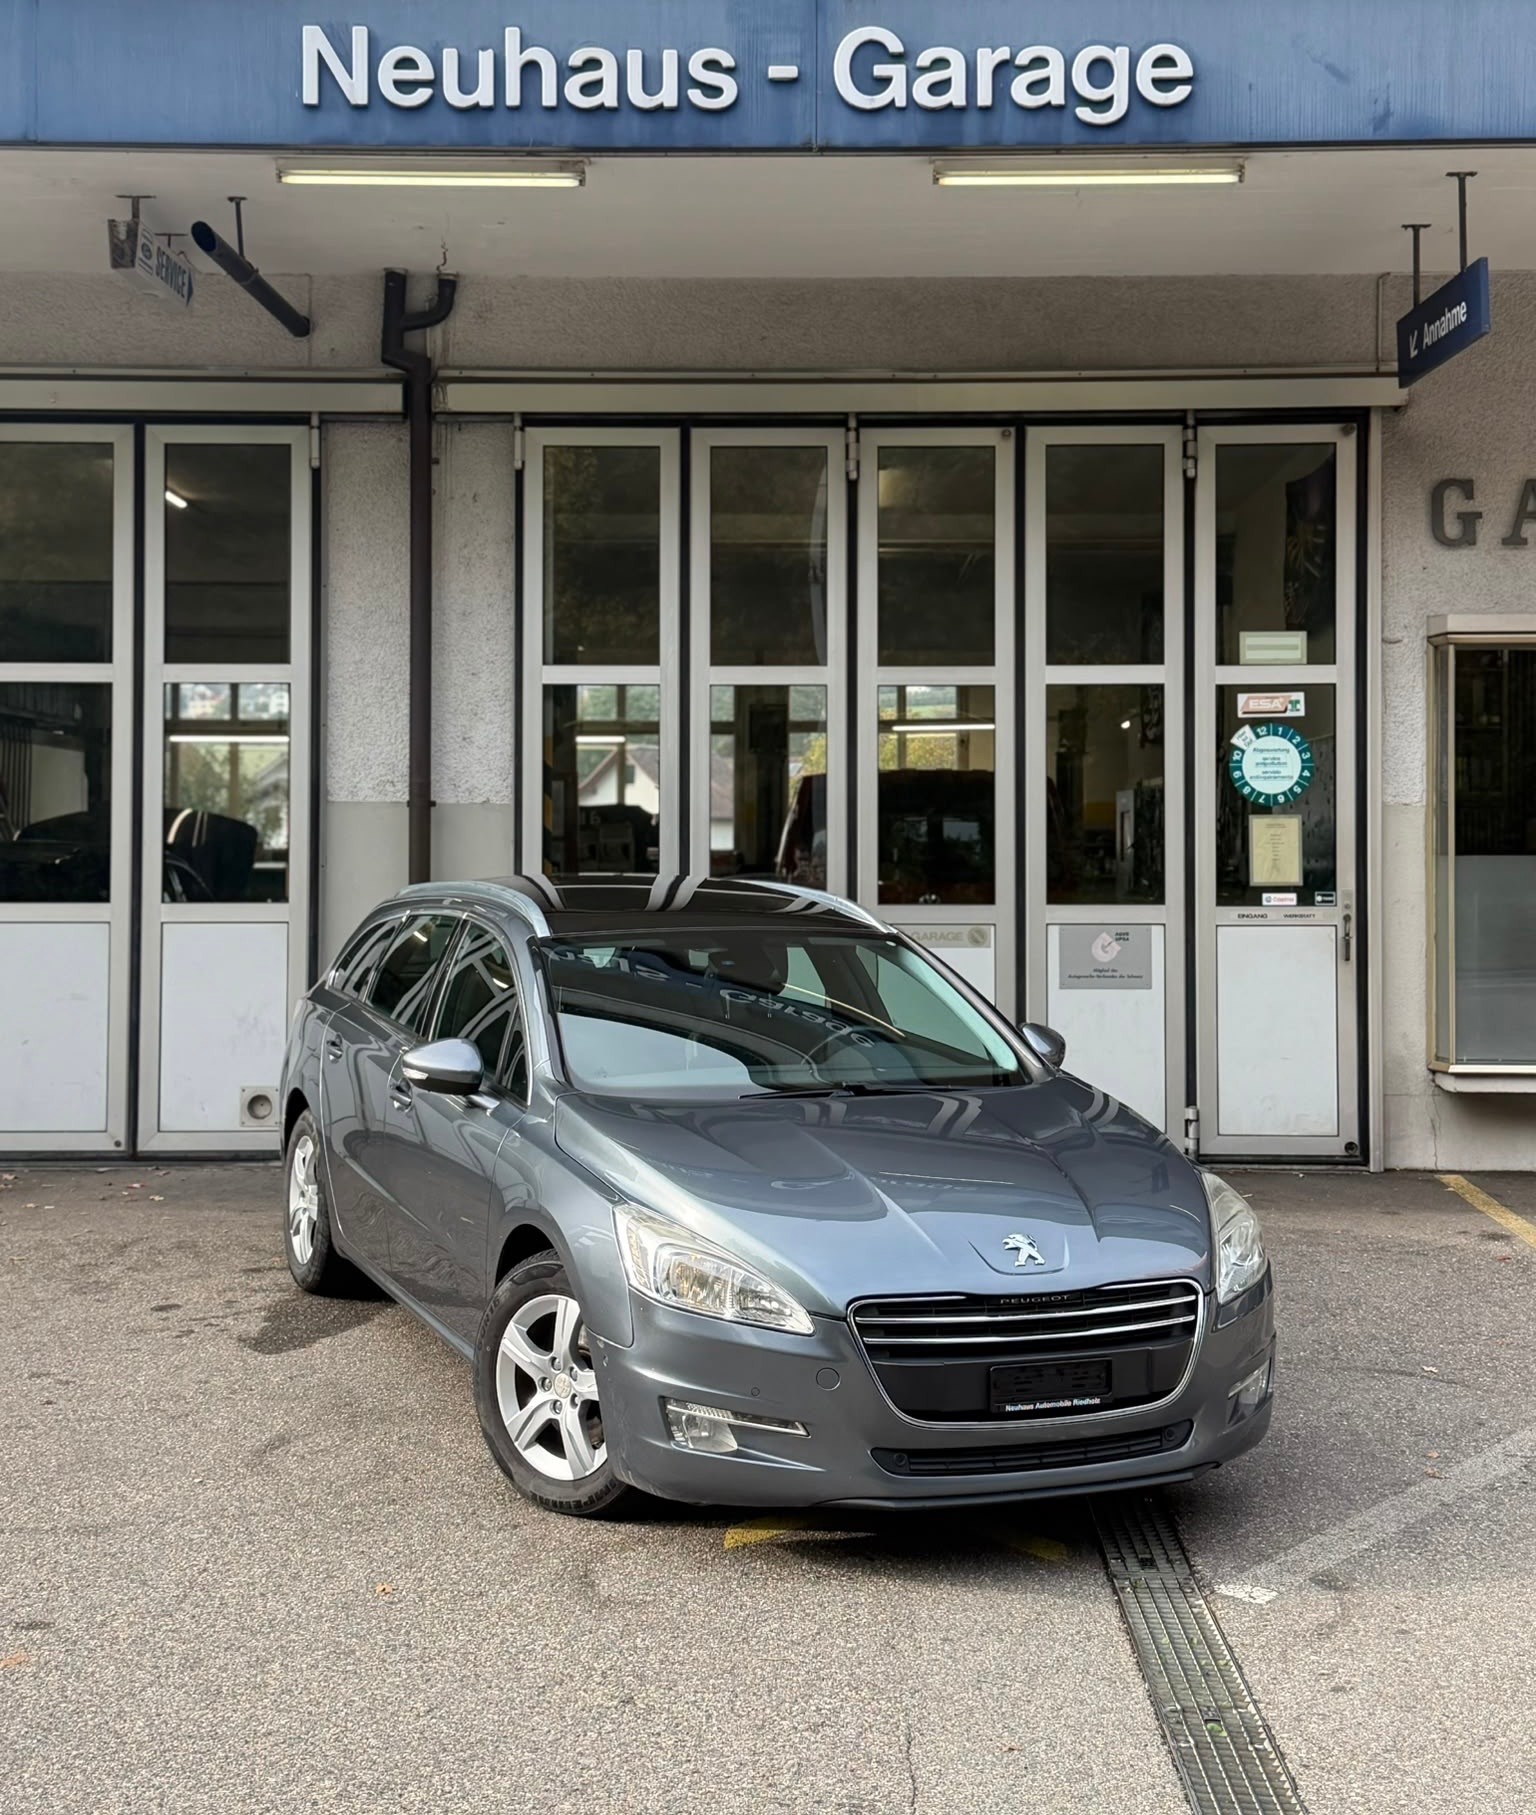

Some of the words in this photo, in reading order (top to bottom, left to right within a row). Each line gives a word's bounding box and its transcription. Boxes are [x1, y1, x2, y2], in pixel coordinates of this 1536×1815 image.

[300, 26, 738, 110] Neuhaus
[833, 25, 1195, 125] Garage
[155, 246, 187, 298] SERVICE
[1422, 300, 1468, 348] Annahme
[1248, 699, 1282, 709] ESA
[1256, 726, 1268, 736] 12
[1277, 727, 1283, 735] 1
[1292, 736, 1301, 744] 2
[1232, 750, 1242, 761] 10
[1242, 786, 1252, 795] 8
[1258, 794, 1266, 803] 7
[1277, 794, 1285, 803] 6
[1000, 1294, 1071, 1304] PEUGEOT
[1005, 1403, 1034, 1412] Neuhaus
[1035, 1401, 1072, 1410] Automobile
[1073, 1397, 1101, 1406] Riedholz
